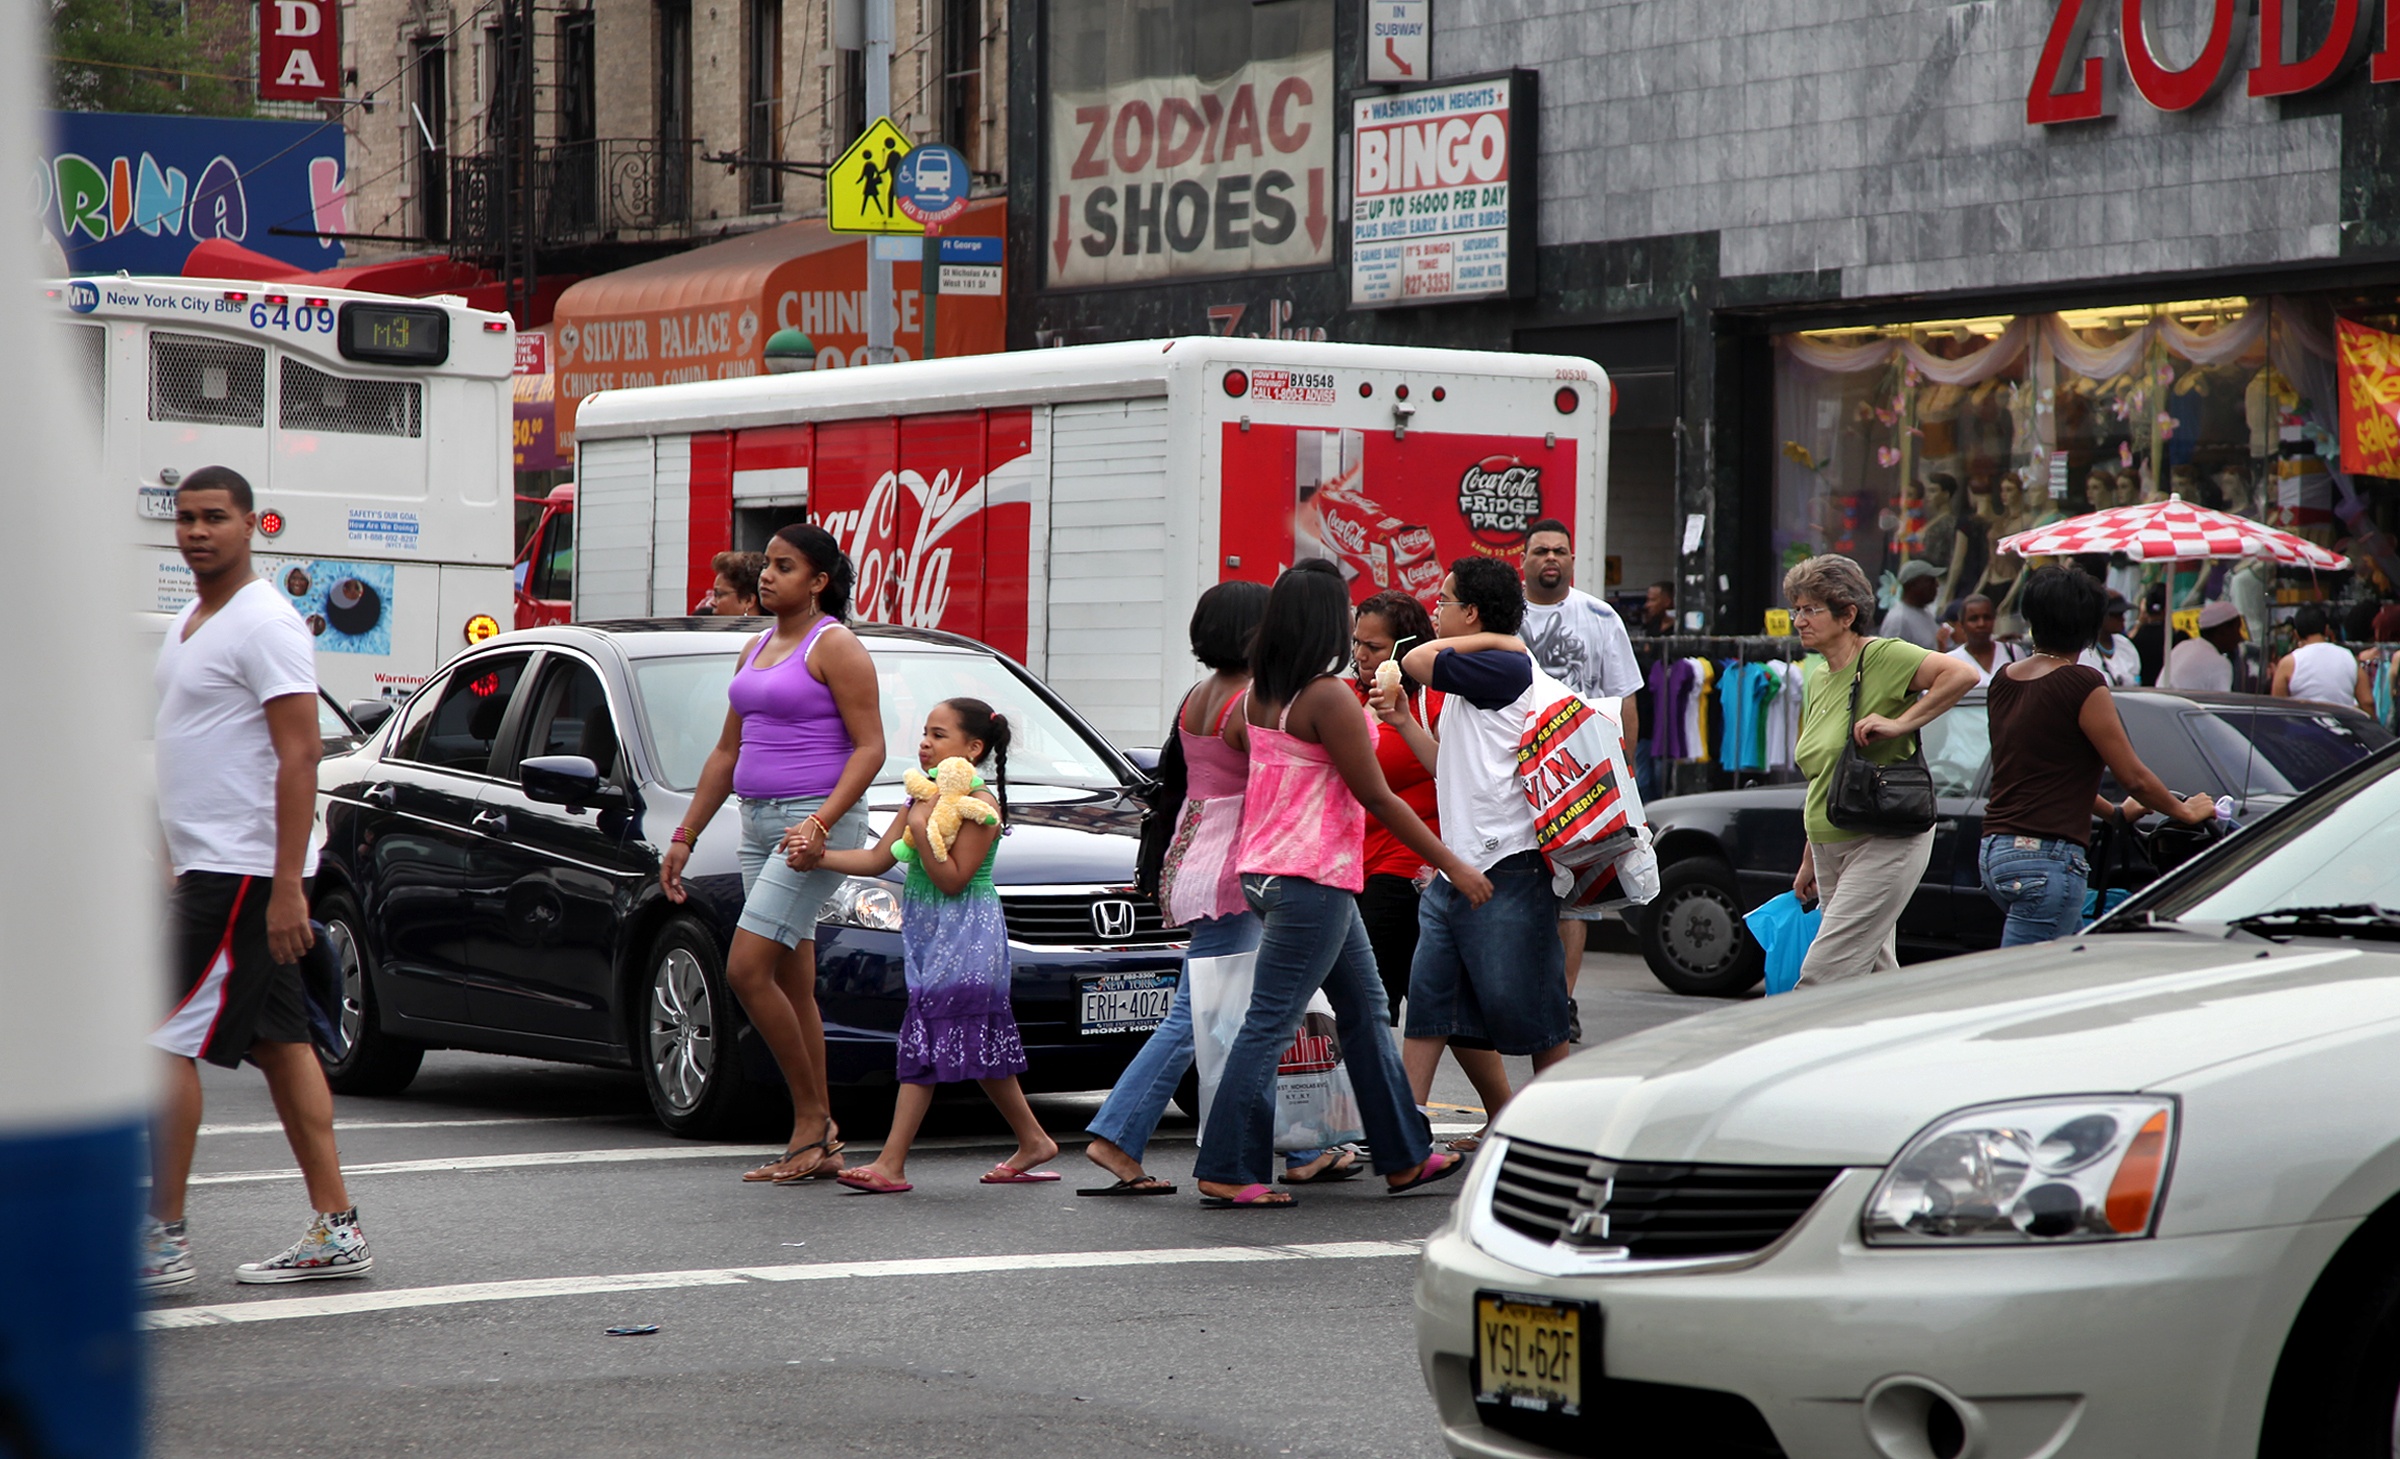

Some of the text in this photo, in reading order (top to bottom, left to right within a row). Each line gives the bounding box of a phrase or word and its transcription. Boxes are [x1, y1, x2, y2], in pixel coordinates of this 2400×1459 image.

[1393, 5, 1405, 18] IN
[1375, 22, 1423, 36] SUBWAY
[1371, 88, 1495, 119] WASHINGTON HEIGHTS
[1071, 76, 1313, 180] ZODIAC
[1359, 113, 1506, 193] BINGO
[28, 150, 247, 242] RINA
[1369, 199, 1384, 219] UP
[1389, 196, 1404, 217] TO
[1409, 192, 1449, 215] $6000
[1453, 188, 1477, 210] PER
[1482, 186, 1507, 207] DAY
[902, 199, 962, 220] NO STANDING
[1081, 169, 1296, 257] SHOES
[1355, 223, 1378, 239] PLUS
[1410, 217, 1437, 233] EARLY
[1442, 216, 1449, 230] &
[1453, 213, 1474, 229] LATE
[1479, 210, 1507, 227] BIRDS
[953, 241, 982, 251] George
[1406, 243, 1451, 257] IT'S BINGO
[951, 268, 980, 277] Nicholas
[68, 285, 95, 306] MTA
[107, 291, 242, 314] New York City Bus
[250, 303, 335, 333] 6409
[374, 315, 410, 348] M3
[583, 311, 731, 363] SILVER PALACE
[1253, 371, 1288, 380] HOW'S MY
[1254, 379, 1287, 387] DRIVING?
[1253, 387, 1335, 402] CALL 1-800-2 ADVISE
[349, 509, 418, 521] SAFETY'S OUR GOAL
[1471, 512, 1527, 531] PACK
[349, 521, 365, 529] How
[366, 521, 379, 529] Are
[380, 522, 392, 530] We
[159, 563, 191, 575] Seeing
[1545, 823, 1558, 839] IN
[1559, 783, 1607, 827] AMERICA
[1103, 979, 1154, 991] NEW YORK
[1081, 1026, 1126, 1035] BRONX
